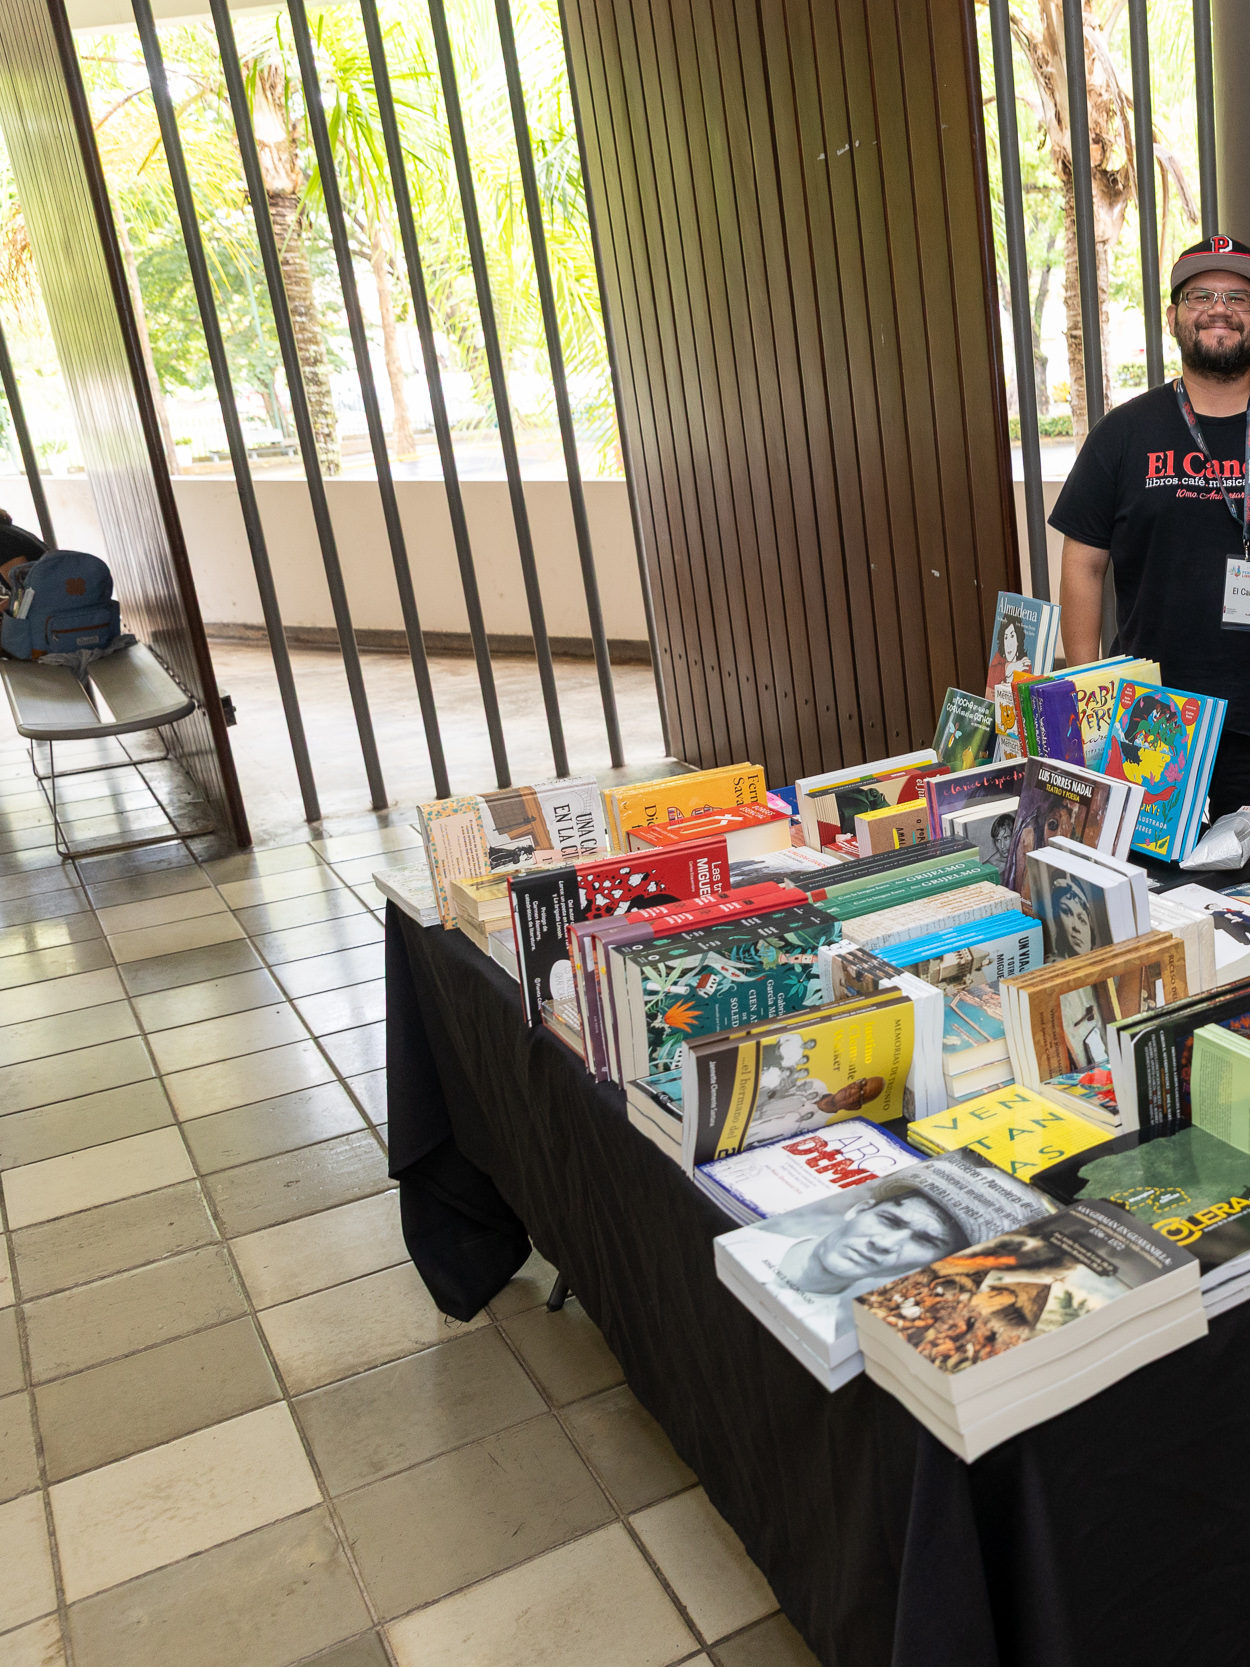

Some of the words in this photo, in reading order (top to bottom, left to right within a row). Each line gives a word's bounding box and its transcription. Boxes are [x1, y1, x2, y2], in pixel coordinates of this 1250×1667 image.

[1211, 235, 1233, 252] P
[1146, 451, 1175, 478] El
[1233, 587, 1239, 595] El
[999, 597, 1038, 623] Almudena
[954, 696, 974, 709] noche
[748, 774, 759, 802] Fern
[1038, 769, 1050, 783] LUIS
[1050, 773, 1072, 790] TORRES
[1072, 782, 1093, 798] NADAL
[1046, 784, 1062, 797] TEATRO
[553, 803, 572, 821] EN
[575, 811, 593, 836] UNA
[1139, 816, 1167, 830] LUSTRADA
[558, 826, 573, 843] LA
[711, 860, 721, 880] Las
[905, 861, 966, 883] GRIJELMO
[920, 866, 981, 889] GRIJELMO
[524, 893, 533, 920] catedrática
[532, 900, 540, 919] Carmen
[539, 906, 547, 925] Prólogo
[559, 902, 567, 915] poeta
[1018, 936, 1029, 950] UN
[996, 953, 1004, 979] MIGUE
[1018, 949, 1030, 972] VIAJ
[1168, 954, 1177, 986] RECESO
[749, 990, 757, 1011] CIEN
[766, 979, 774, 1006] García
[730, 998, 739, 1028] SOLED
[1047, 1008, 1059, 1040] VIVENCIAS
[863, 1021, 875, 1064] Justino
[892, 1018, 902, 1065] MEMORIAS
[731, 1074, 751, 1119] hermano
[882, 1076, 898, 1111] TRIUNFO
[727, 1120, 738, 1140] del
[1089, 1207, 1117, 1234] GERMÁN
